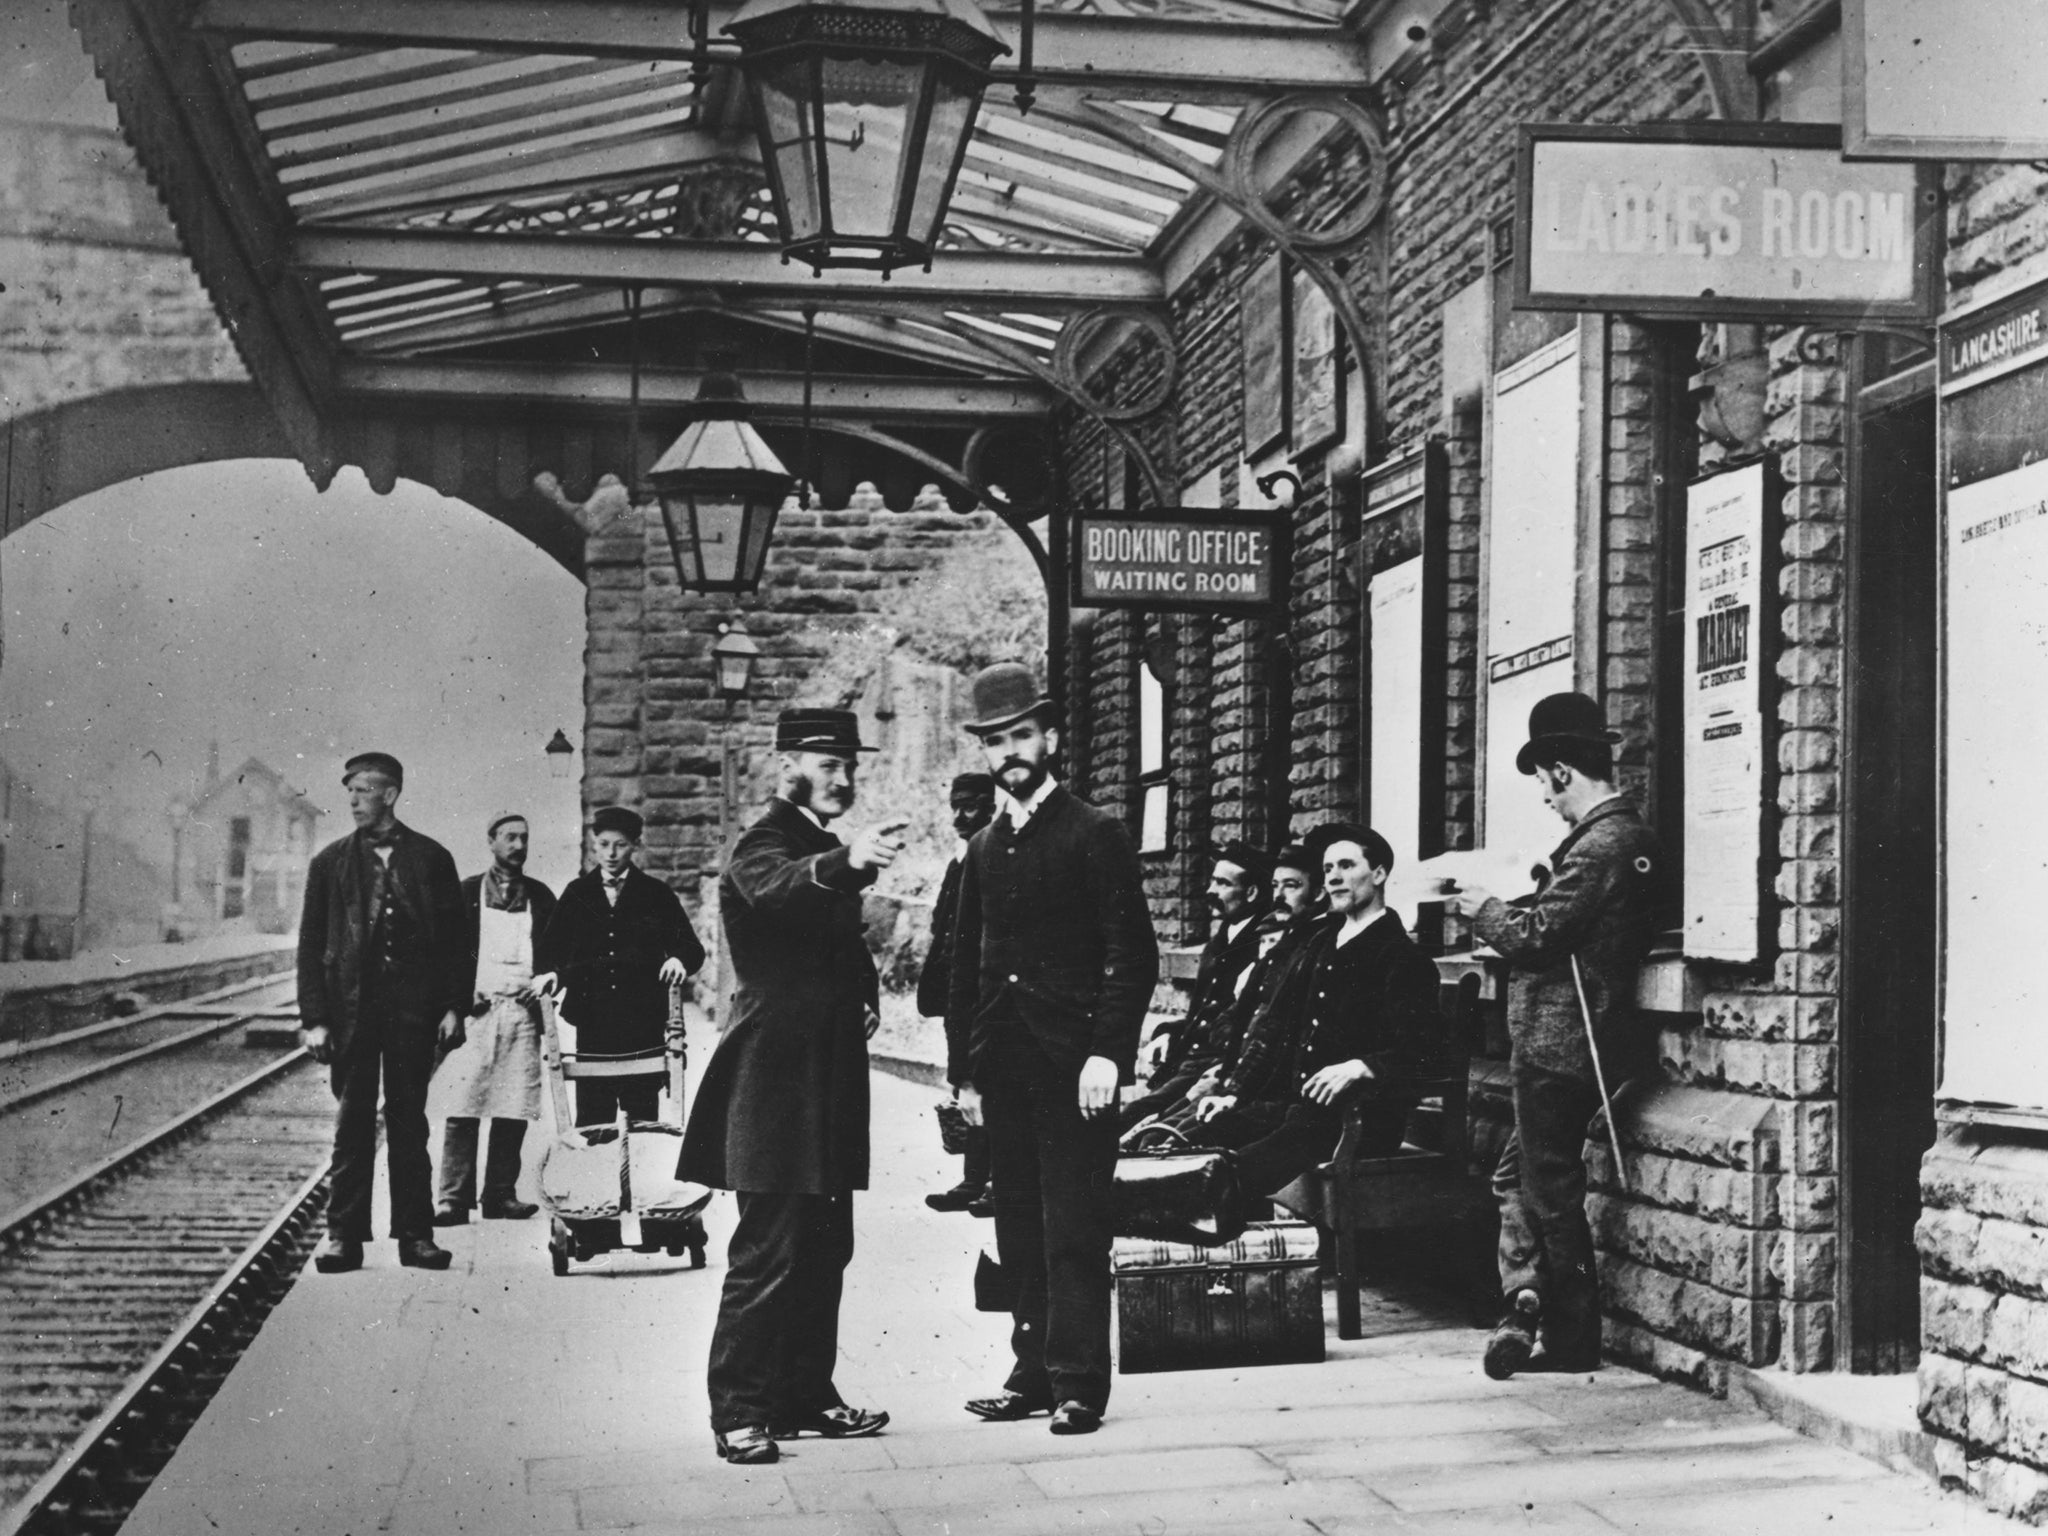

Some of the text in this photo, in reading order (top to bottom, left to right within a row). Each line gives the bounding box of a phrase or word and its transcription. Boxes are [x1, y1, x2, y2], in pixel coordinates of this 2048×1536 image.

[1761, 187, 1905, 261] ROOM
[1952, 309, 2040, 373] LANCASHIRE
[1088, 527, 1262, 565] BOOKING OFFICE
[1094, 570, 1256, 593] WAITING ROOM
[1697, 604, 1751, 674] MARKET
